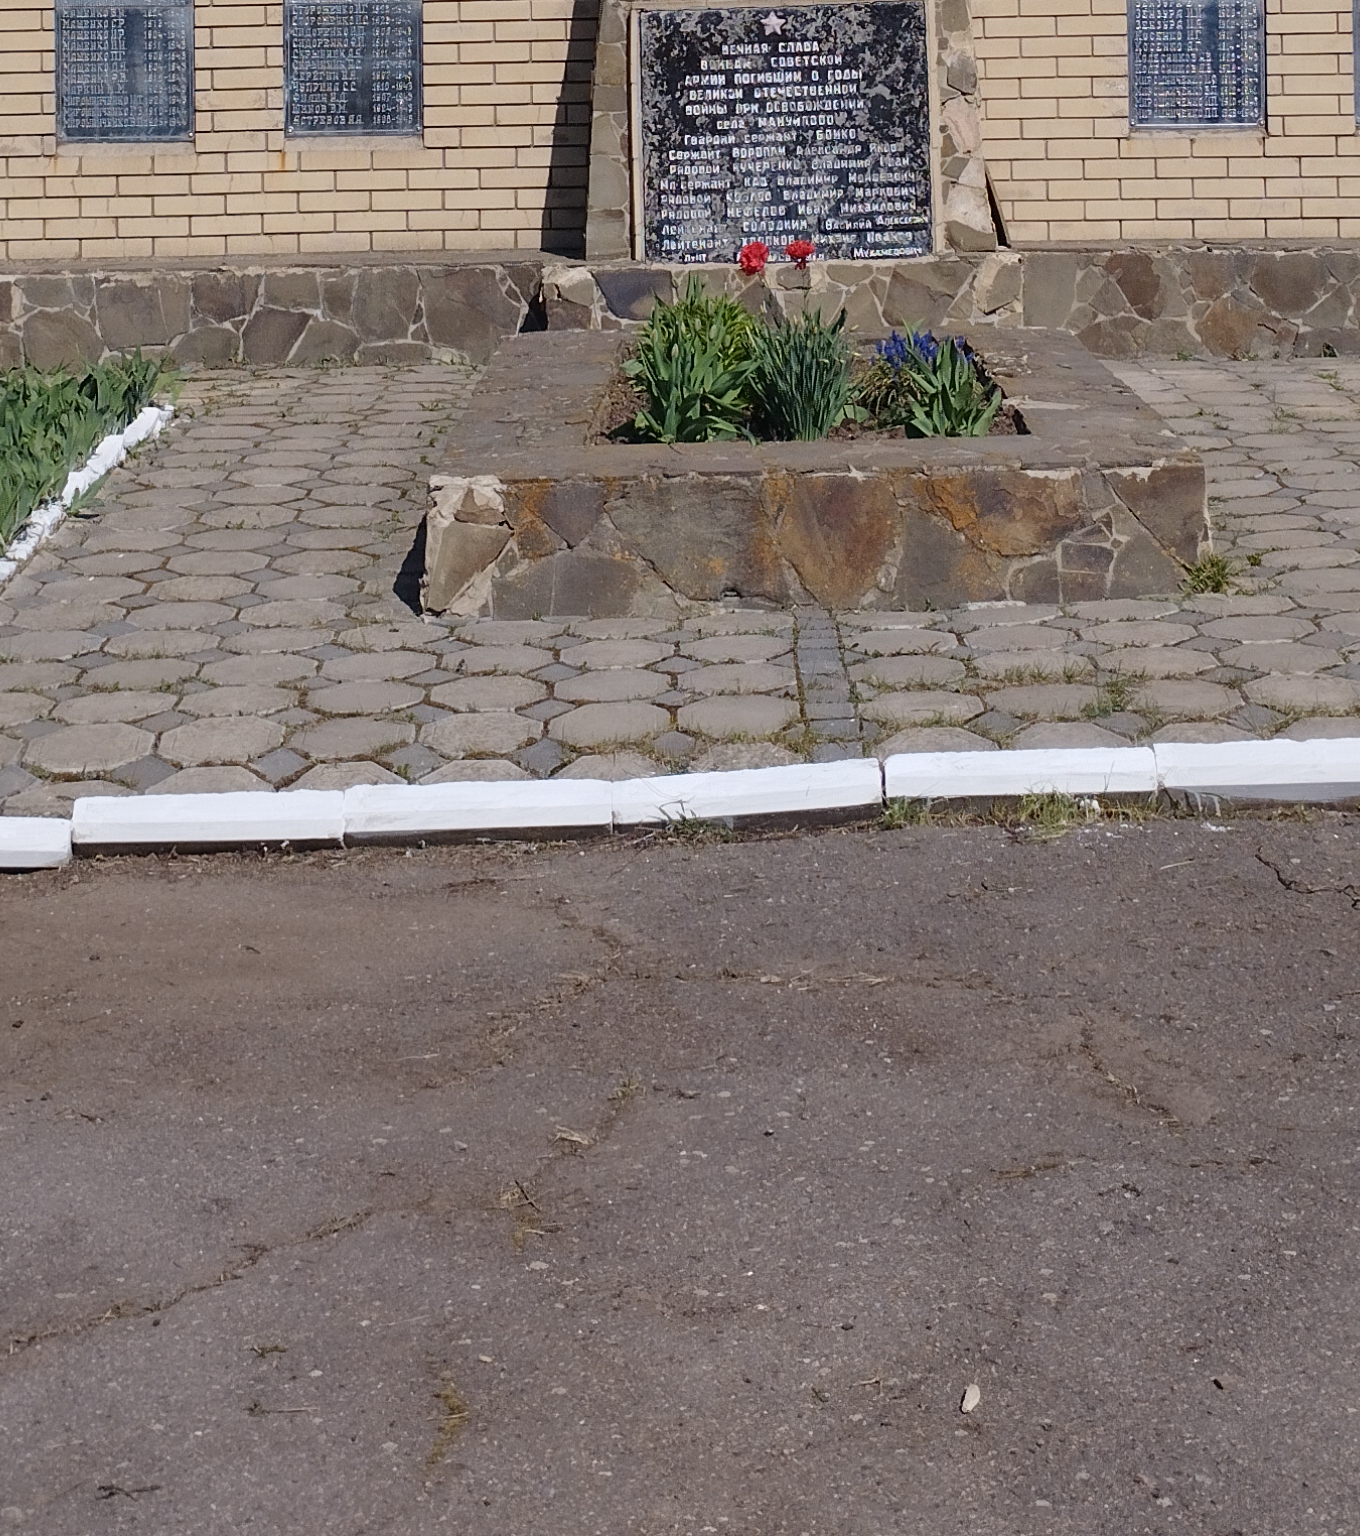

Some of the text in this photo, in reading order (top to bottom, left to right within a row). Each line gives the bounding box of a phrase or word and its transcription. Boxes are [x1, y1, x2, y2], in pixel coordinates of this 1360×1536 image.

[721, 40, 820, 55] ВЕЧНАЯ СЛАВА
[684, 69, 863, 86] АРМИИ ПОГИБШИМ В ГОДЫ
[735, 102, 759, 114] ПРИ
[765, 98, 865, 113] ОСВОБОЖДЕНИИ
